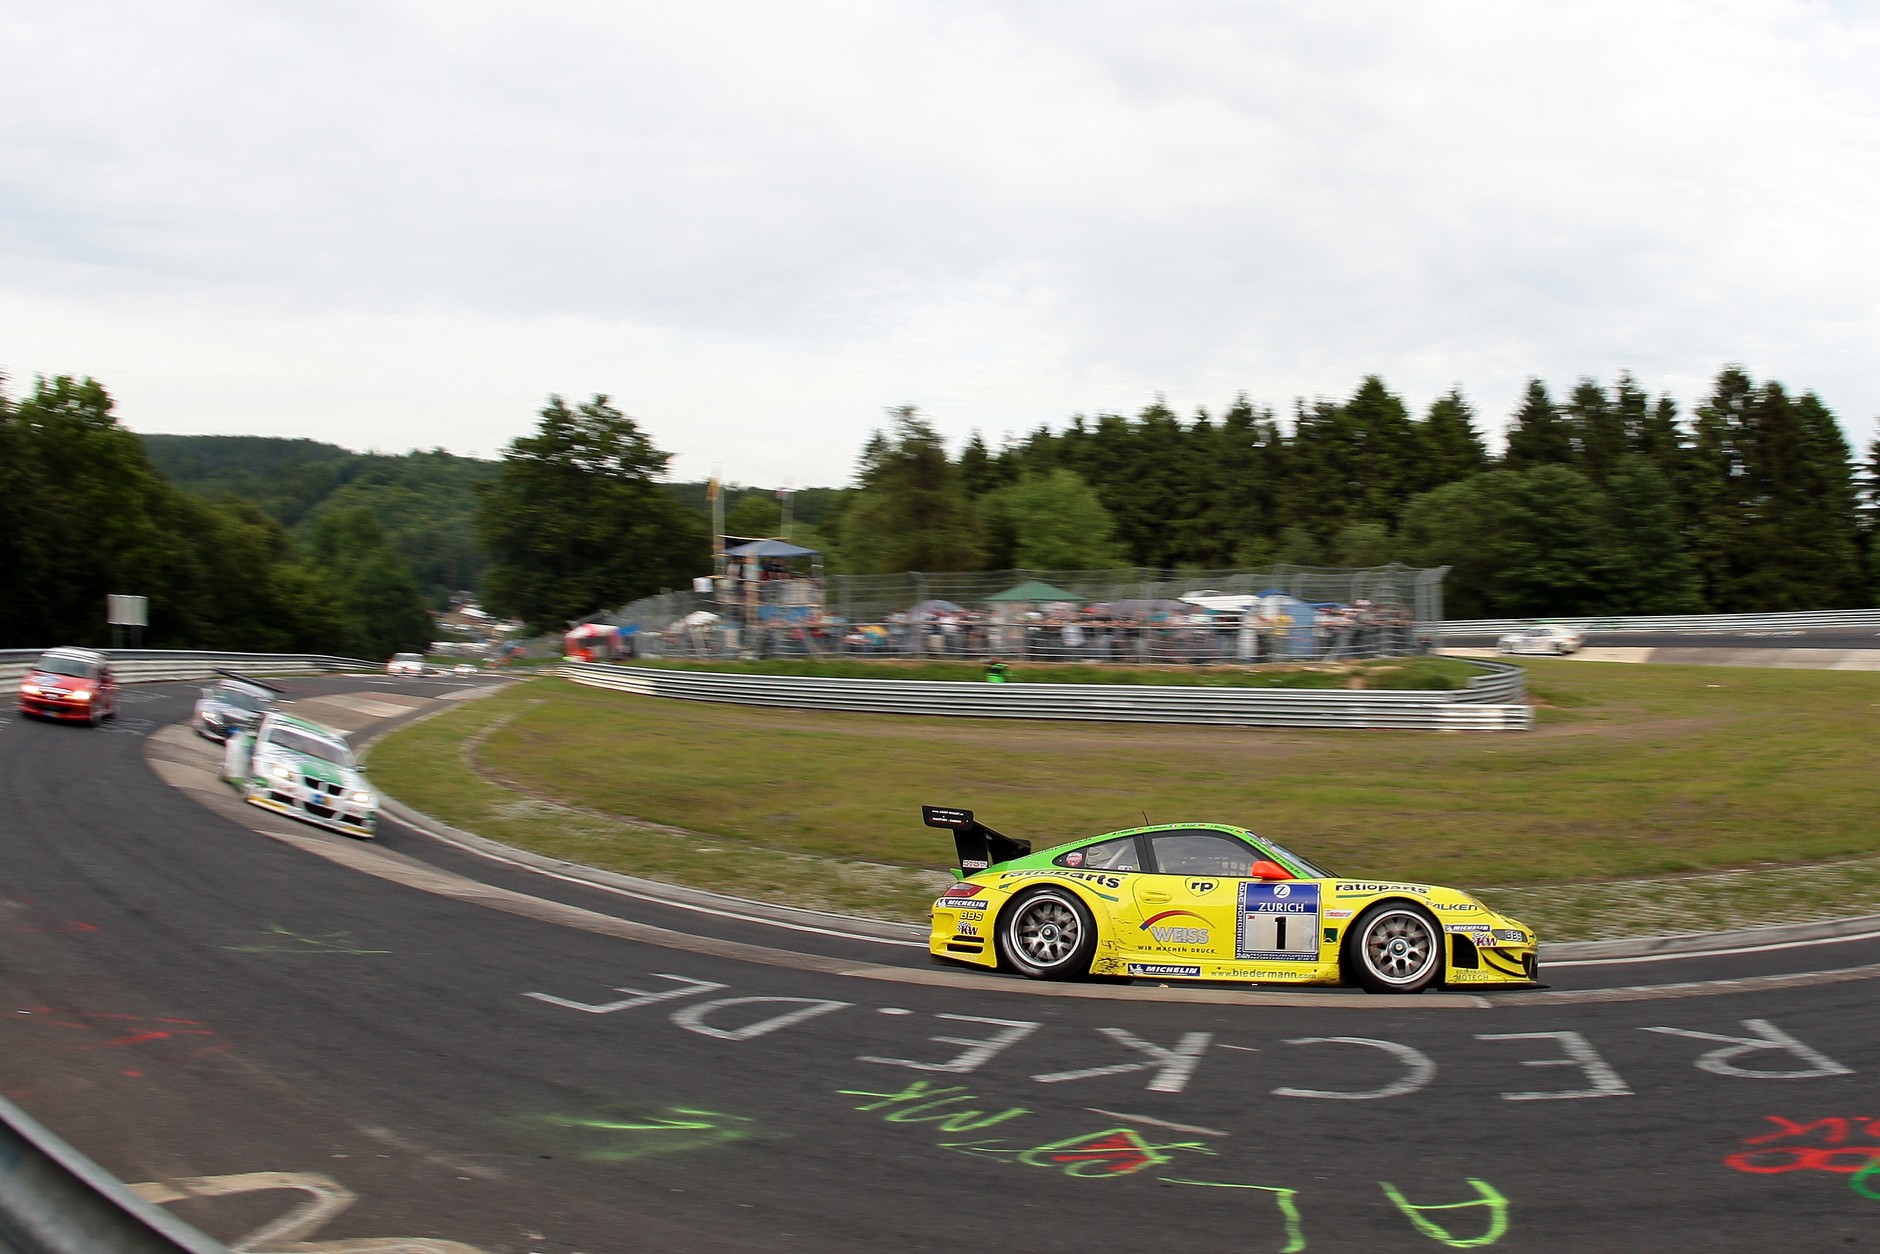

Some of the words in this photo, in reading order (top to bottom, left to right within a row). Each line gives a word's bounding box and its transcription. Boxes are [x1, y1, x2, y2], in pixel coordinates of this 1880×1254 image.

[1191, 881, 1214, 892] rp
[1335, 883, 1428, 894] ratioparts
[946, 899, 987, 908] MICHELIN
[1258, 902, 1305, 912] ZURICH
[959, 910, 984, 922] BBS
[1236, 904, 1245, 953] NORDRHEIN
[1275, 916, 1287, 950] 1
[1151, 926, 1210, 945] WEISS
[1145, 966, 1198, 974] MICHELIN
[1210, 968, 1317, 979] www.biedermann.com
